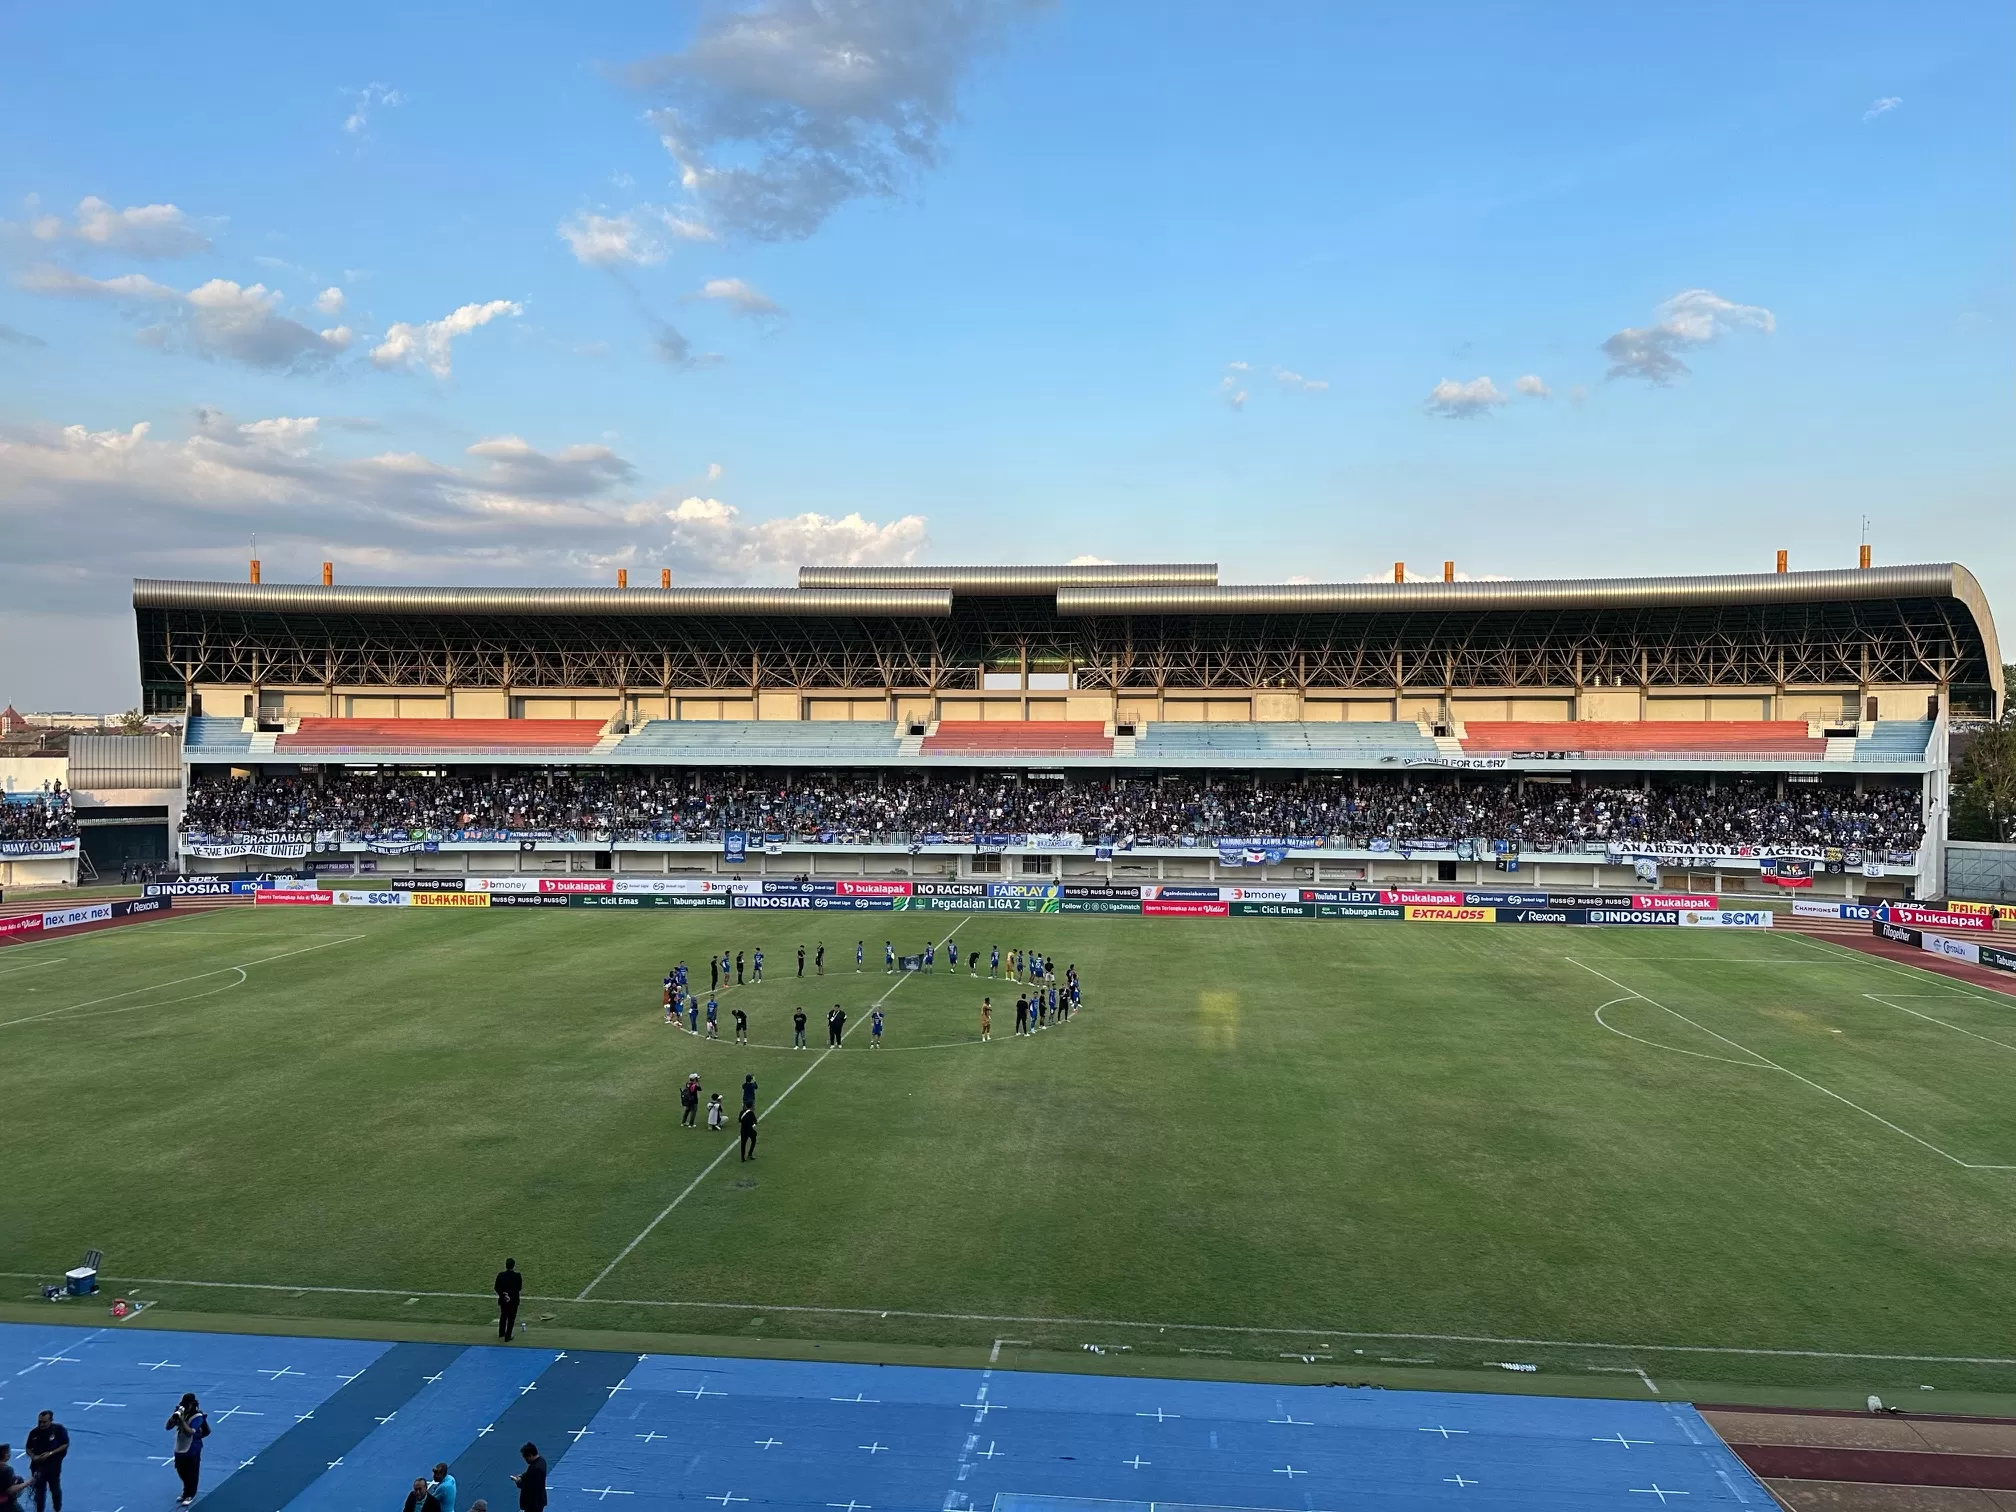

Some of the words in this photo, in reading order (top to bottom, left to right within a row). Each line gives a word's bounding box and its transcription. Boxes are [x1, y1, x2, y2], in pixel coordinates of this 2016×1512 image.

[1451, 758, 1471, 768] FOR
[224, 845, 247, 855] KIDS
[249, 844, 268, 854] ARE
[270, 844, 305, 856] UNITED
[1621, 843, 1640, 852] AN
[1644, 843, 1695, 855] ARENA
[1699, 845, 1726, 856] FOR
[1764, 847, 1824, 859] ACTION
[162, 883, 230, 895] INDOSIAR
[489, 880, 527, 890] bmoney
[558, 882, 607, 892] bukalapak
[711, 882, 749, 892] bmoney
[856, 884, 905, 894] bukalapak
[917, 885, 935, 895] NO
[937, 885, 983, 895] RACISM!
[993, 886, 1044, 897] FAIRPLAY
[1244, 890, 1287, 900] bmoney
[1314, 892, 1337, 901] YouTube
[368, 892, 400, 904] SCM
[600, 897, 617, 906] Cicil
[618, 898, 639, 906] Emas
[673, 897, 706, 907] Tabungan
[706, 898, 726, 906] Emas
[747, 897, 811, 908] INDOSIAR
[1401, 893, 1456, 904] bukalapak
[1654, 898, 1711, 909] bukalapak
[133, 901, 160, 913] Rexona
[987, 899, 1014, 910] LIGA
[1014, 899, 1021, 910] 2
[1061, 902, 1082, 910] Follow
[1203, 905, 1225, 913] Vidio
[1261, 905, 1279, 914] Cicil
[1281, 906, 1303, 915] Emas
[45, 914, 65, 927] nex
[69, 911, 88, 923] nex
[91, 908, 110, 920] nex
[1341, 907, 1377, 917] Tabungan
[1378, 908, 1400, 916] Emas
[1528, 912, 1566, 922] Rexona
[1605, 911, 1677, 923] INDOSIAR
[1845, 906, 1883, 919] nex
[1721, 912, 1759, 925] SCM
[1915, 911, 1984, 927] bukalapak
[1882, 923, 1911, 943] Fitogether
